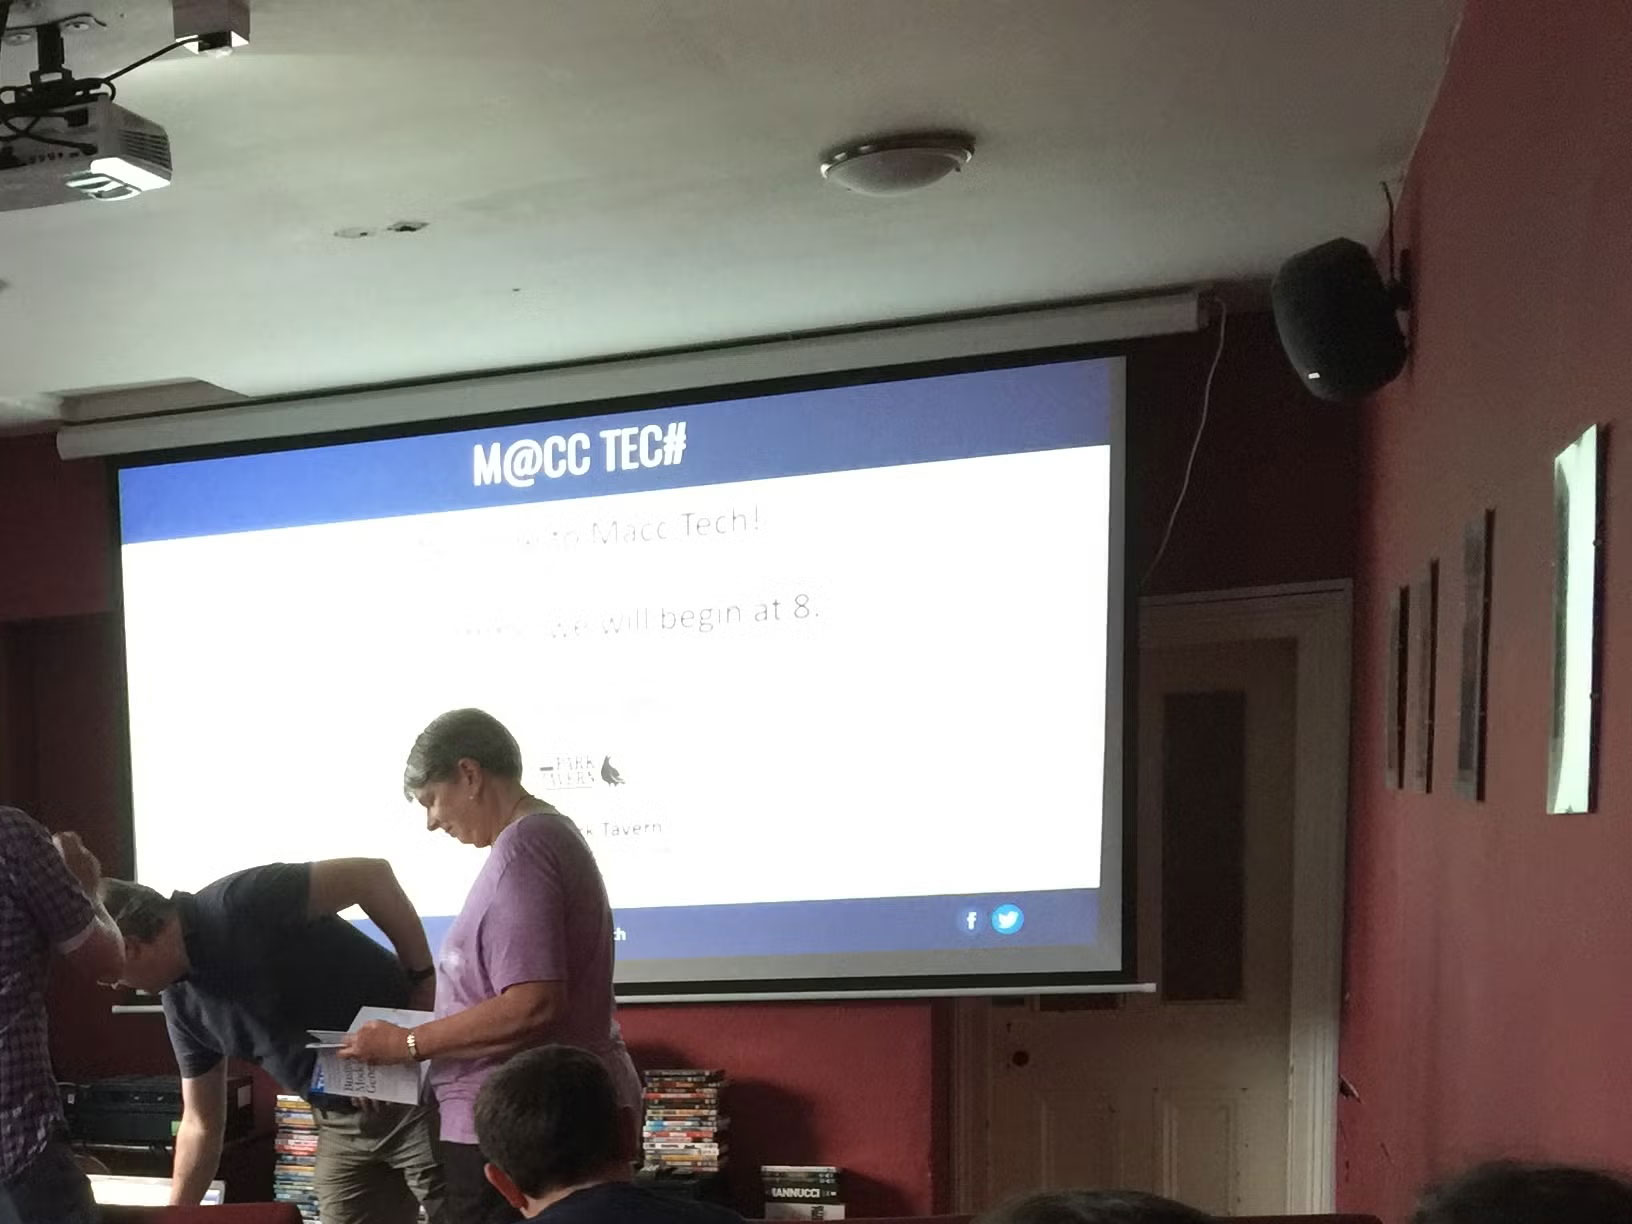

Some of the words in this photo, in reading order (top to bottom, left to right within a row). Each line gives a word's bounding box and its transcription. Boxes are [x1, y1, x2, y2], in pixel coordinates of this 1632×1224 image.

[473, 432, 591, 488] M@CC
[599, 421, 687, 473] TEC#
[591, 519, 668, 545] Macc
[681, 502, 760, 537] Tech!
[602, 606, 648, 635] will
[661, 602, 741, 634] begin
[754, 598, 782, 623] at
[793, 593, 820, 620] 8.
[602, 822, 662, 838] Tavern
